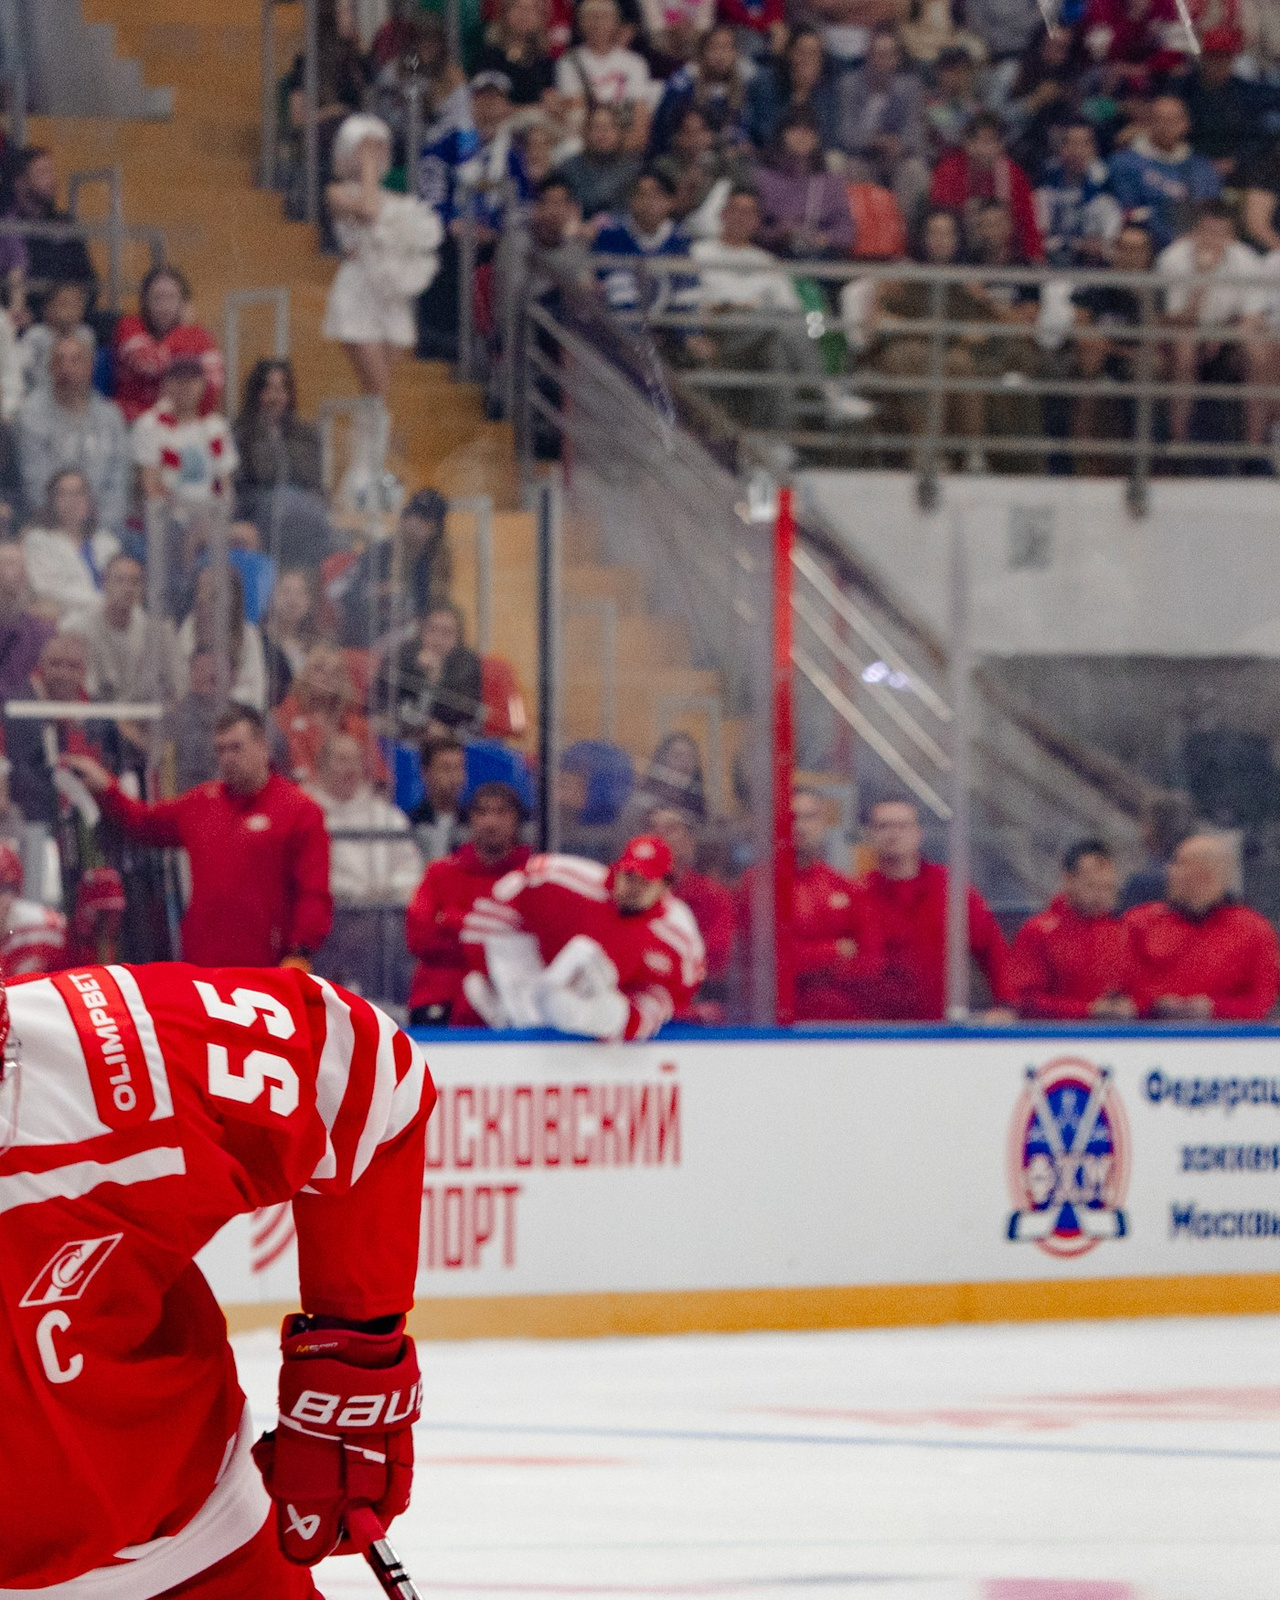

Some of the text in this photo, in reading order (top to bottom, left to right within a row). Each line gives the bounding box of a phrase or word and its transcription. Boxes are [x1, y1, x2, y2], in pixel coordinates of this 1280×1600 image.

[68, 973, 137, 1111] OLIMPBET
[192, 980, 300, 1117] 55
[424, 1062, 681, 1168] ОСКОВСКИЙ
[423, 1184, 522, 1268] ПОРТ
[36, 1309, 83, 1383] C
